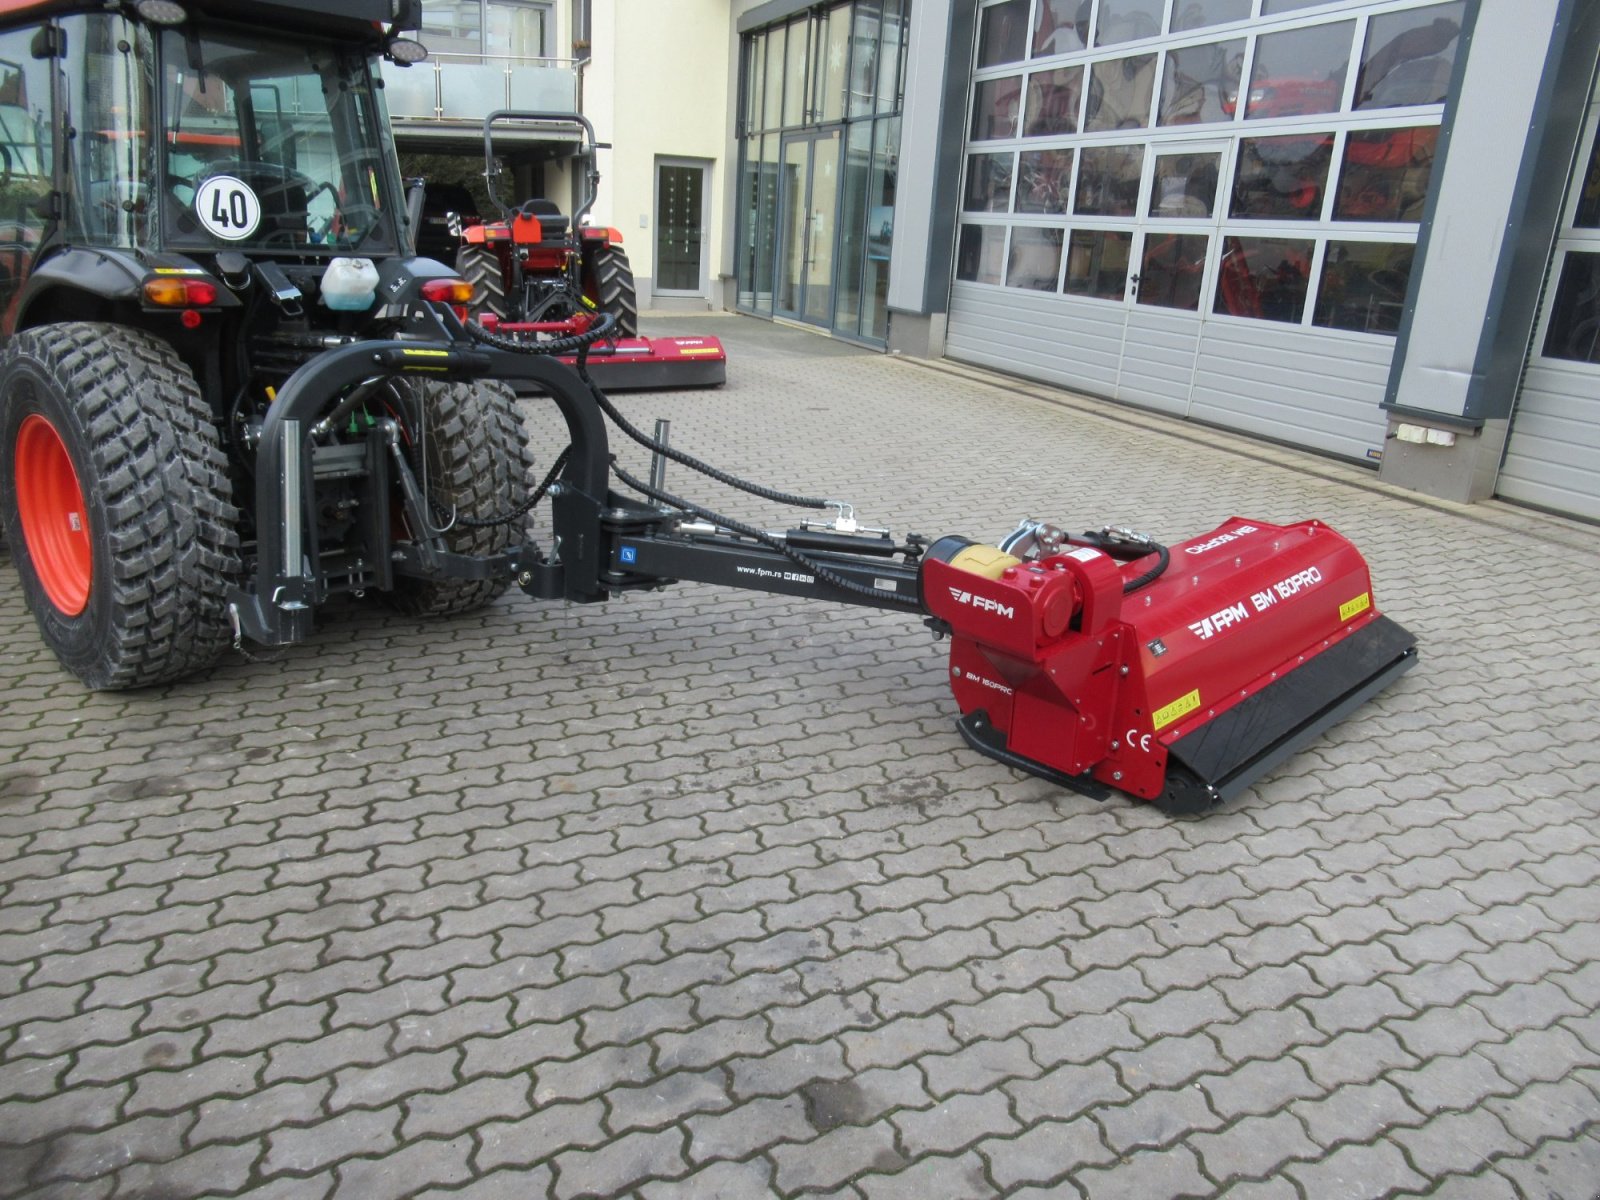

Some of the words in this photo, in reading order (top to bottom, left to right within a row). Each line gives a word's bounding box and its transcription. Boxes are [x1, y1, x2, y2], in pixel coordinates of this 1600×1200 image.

[212, 188, 247, 229] 40
[737, 565, 782, 578] www.fpm.rs
[973, 595, 1014, 619] FPM
[1210, 601, 1249, 632] FPM
[1250, 588, 1277, 612] BM
[1273, 566, 1322, 599] 160PRO
[966, 672, 980, 682] BM
[1126, 729, 1152, 752] CE
